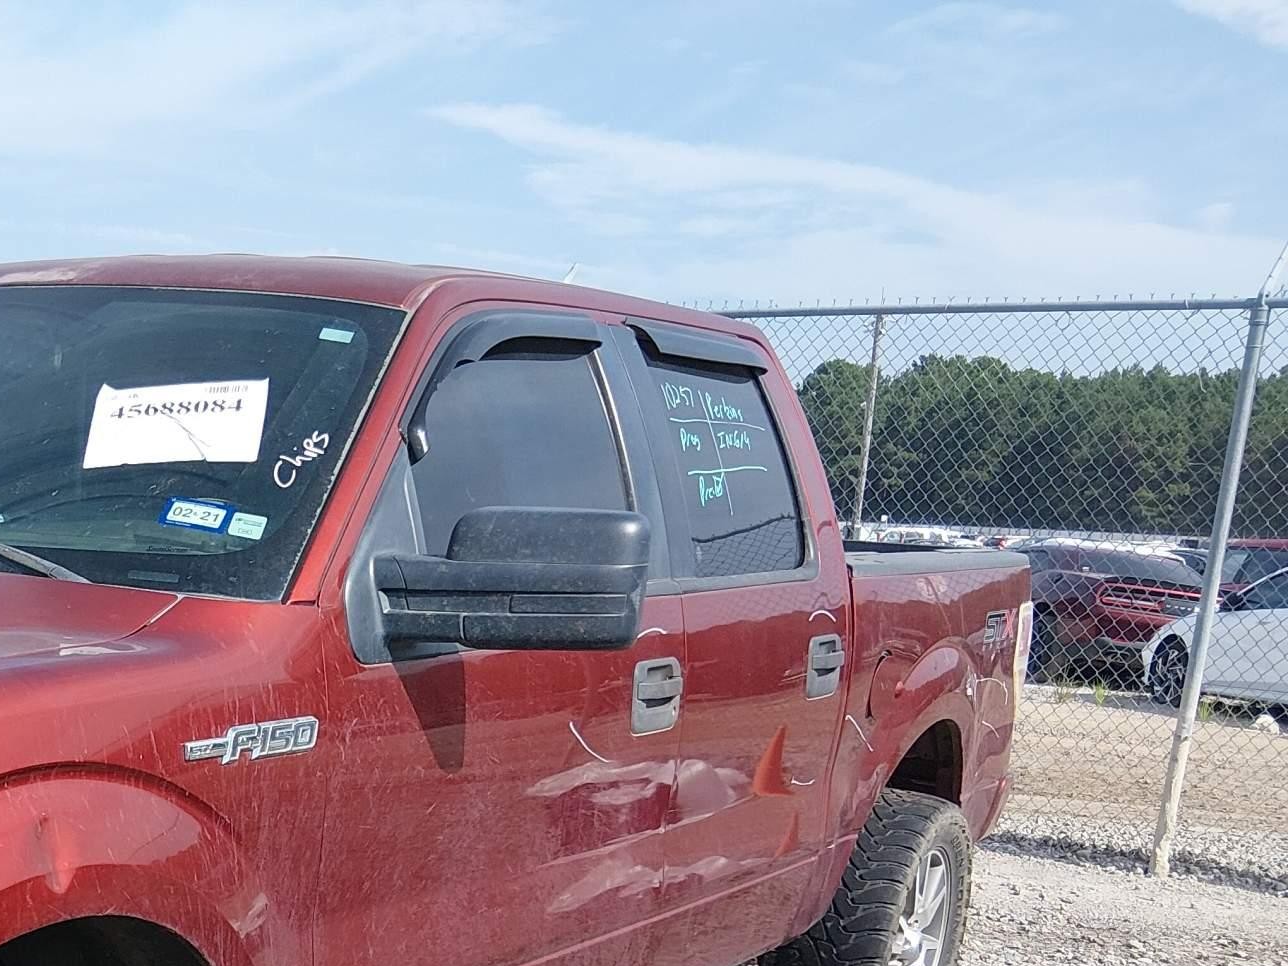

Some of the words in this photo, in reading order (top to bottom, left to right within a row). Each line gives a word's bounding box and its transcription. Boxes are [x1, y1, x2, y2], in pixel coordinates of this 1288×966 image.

[109, 398, 244, 420] 45688084
[272, 430, 330, 489] Chips
[984, 608, 1018, 643] STX
